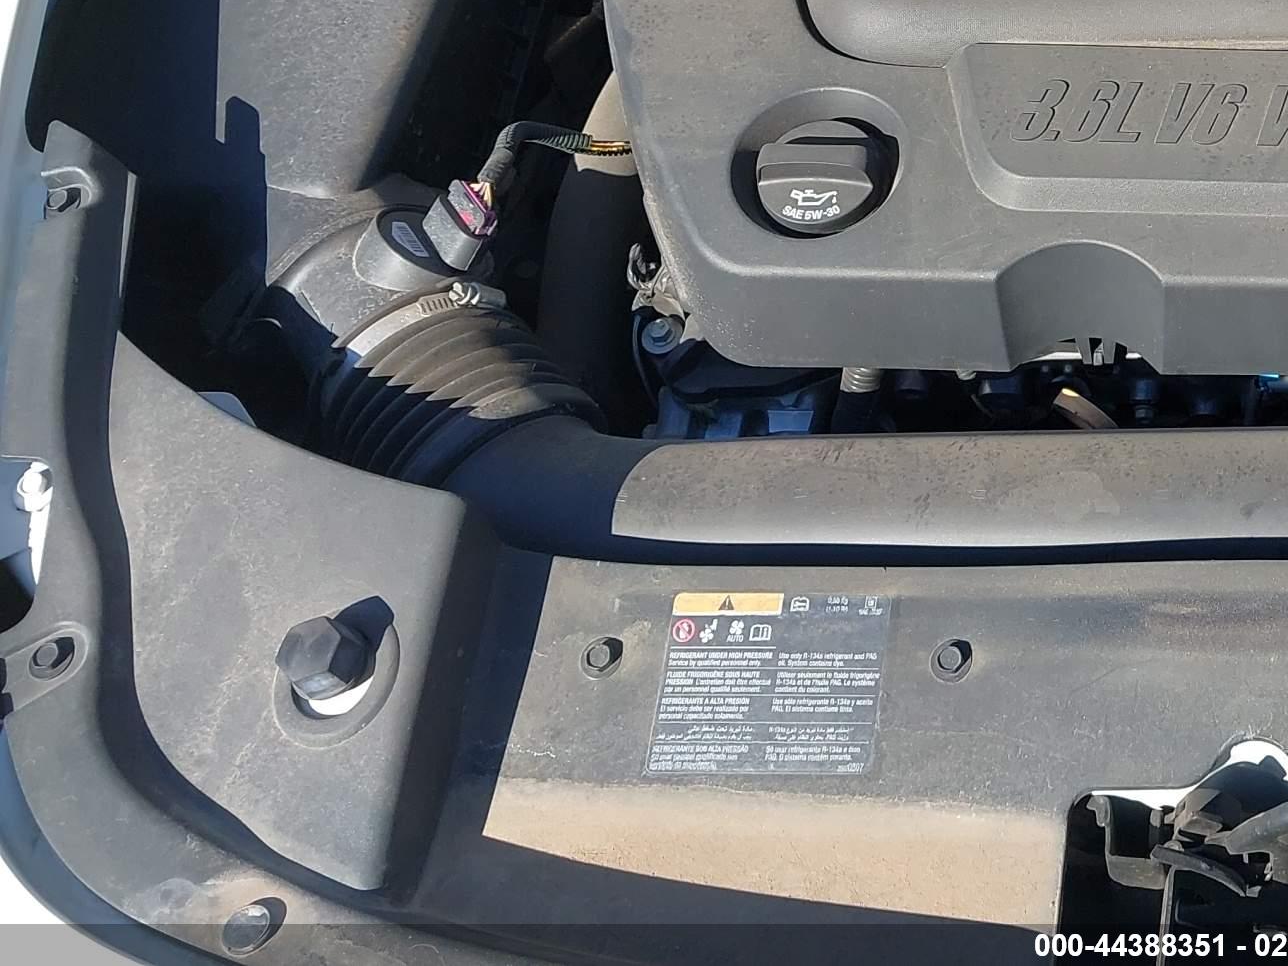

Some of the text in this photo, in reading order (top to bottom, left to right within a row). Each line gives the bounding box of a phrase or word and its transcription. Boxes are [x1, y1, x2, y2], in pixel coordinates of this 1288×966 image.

[1010, 79, 1144, 143] 3.6L
[1153, 82, 1249, 146] V6
[782, 205, 840, 220] SAE 5W-30
[726, 634, 744, 642] AUTO
